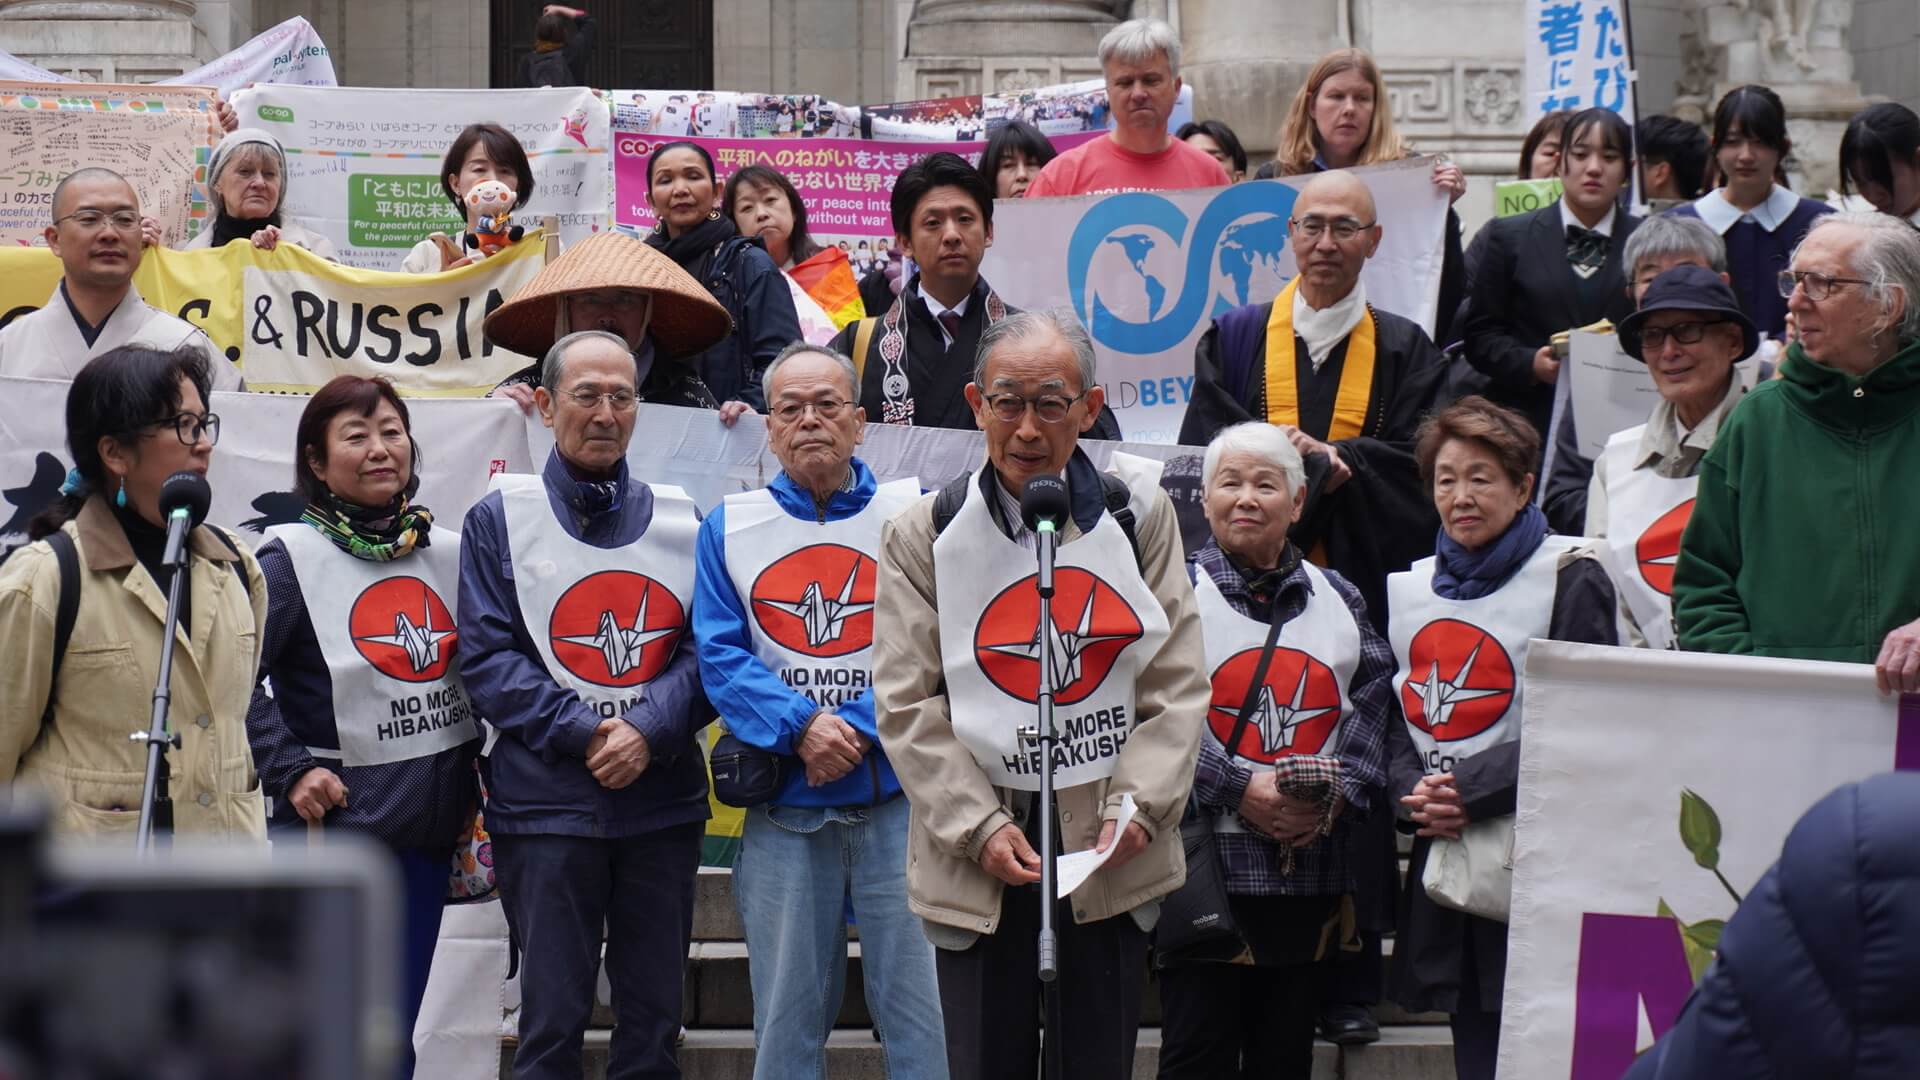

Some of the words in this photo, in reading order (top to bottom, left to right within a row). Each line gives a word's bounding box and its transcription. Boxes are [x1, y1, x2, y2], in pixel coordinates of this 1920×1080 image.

[822, 198, 864, 212] peace
[1504, 193, 1539, 213] NO
[354, 220, 370, 229] For
[379, 220, 420, 231] peaceful
[422, 220, 450, 230] future
[806, 212, 858, 226] without
[861, 215, 887, 227] war
[365, 233, 380, 241] the
[382, 234, 412, 243] power
[252, 295, 283, 350] &
[782, 668, 809, 687] NO
[391, 696, 421, 717] NO
[426, 684, 461, 711] MORE
[377, 702, 472, 741] HIBAKUSHA
[1065, 705, 1127, 741] MORE
[1002, 727, 1132, 775] HIBAKUSH
